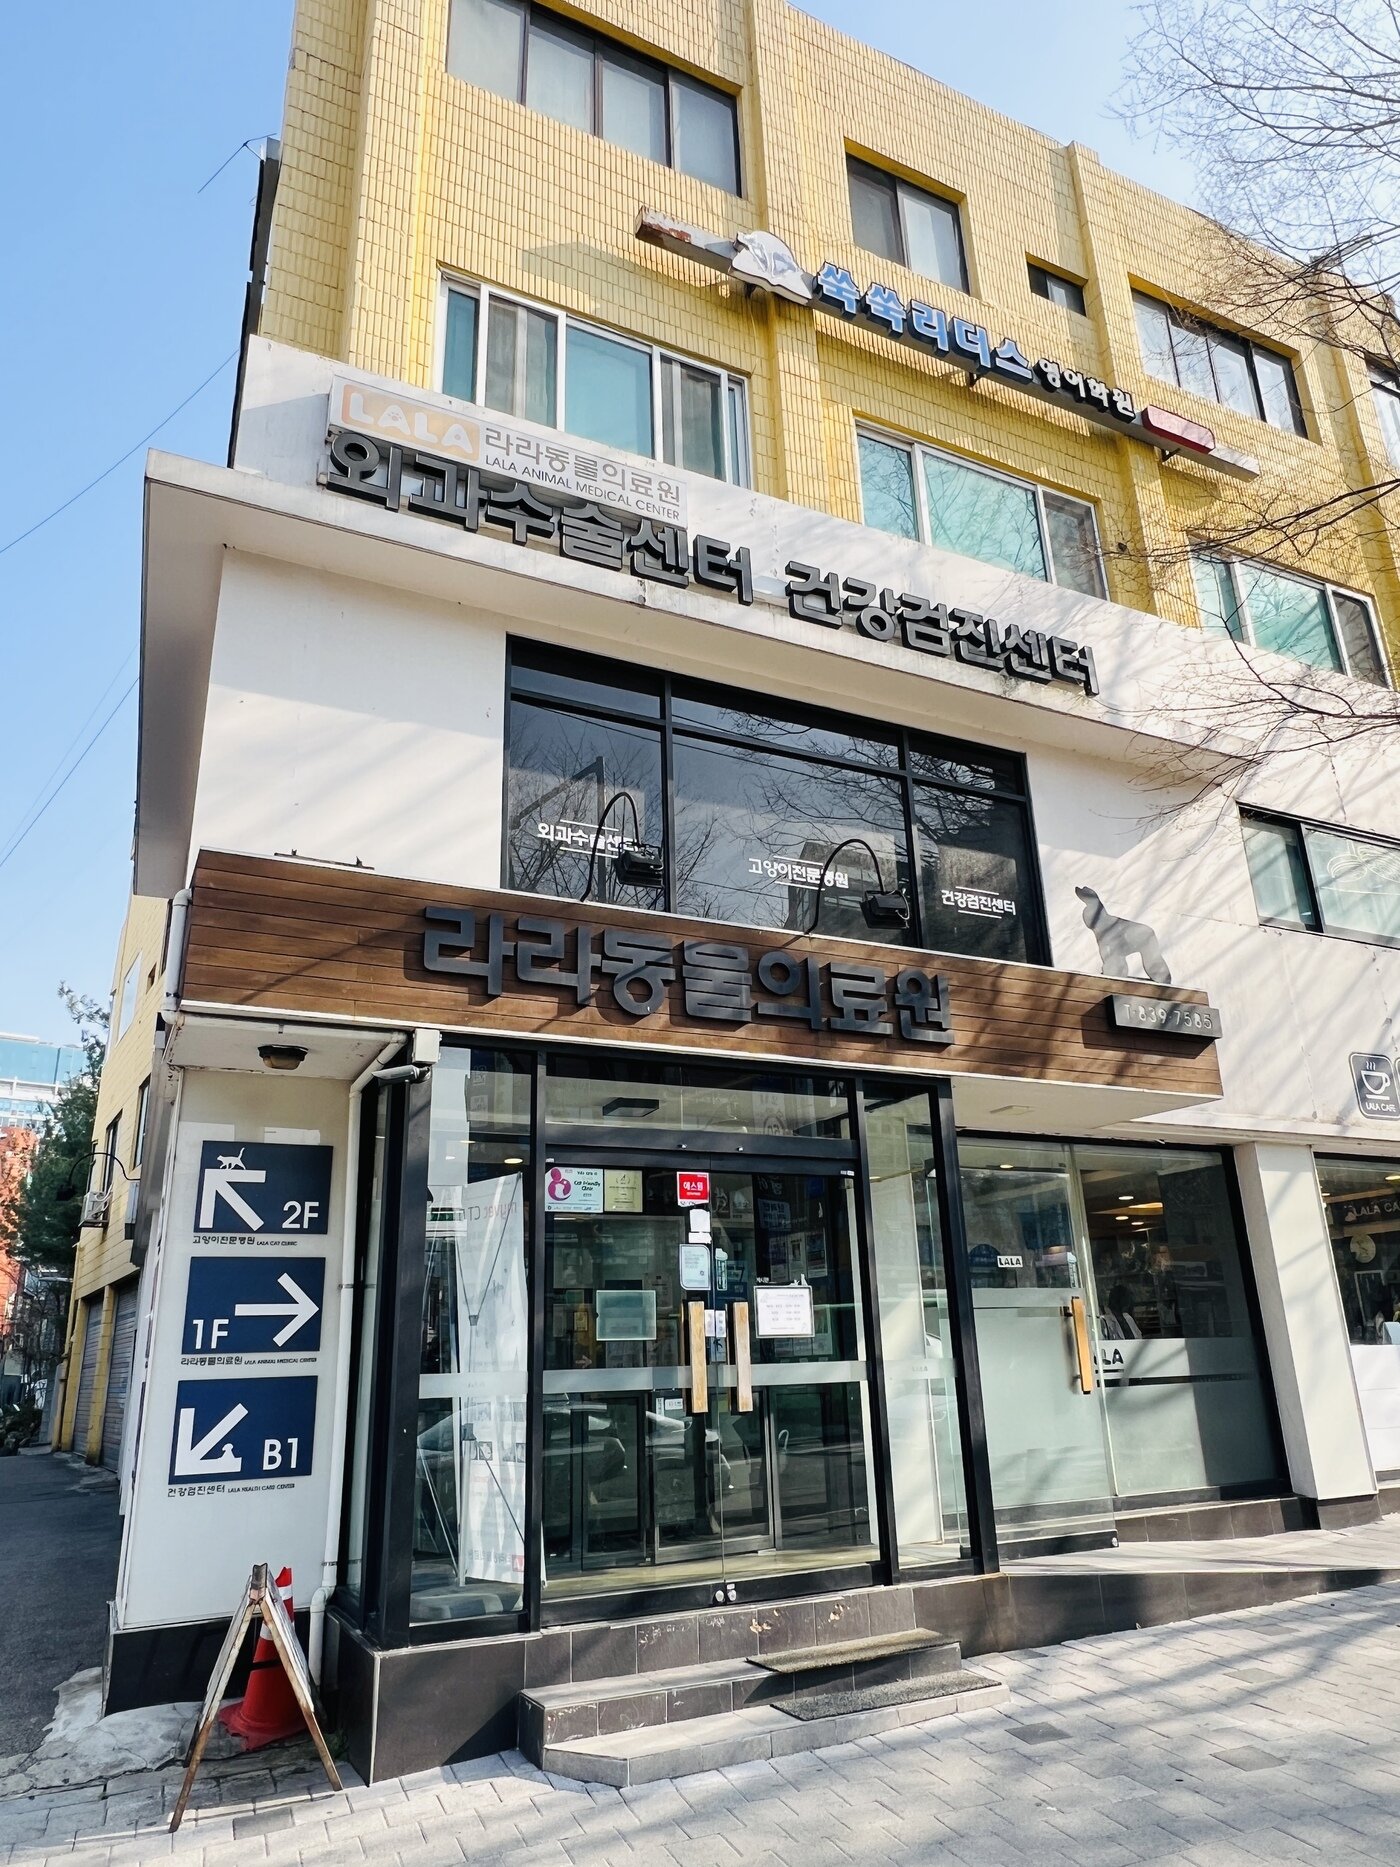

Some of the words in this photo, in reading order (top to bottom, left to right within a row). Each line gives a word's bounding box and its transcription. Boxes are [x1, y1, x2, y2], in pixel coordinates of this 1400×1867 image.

[816, 261, 1034, 383] 쑥쑥리더스
[1035, 357, 1136, 424] 영어학원
[347, 392, 475, 455] LALA
[485, 427, 680, 508] 라라동물의료원
[485, 454, 518, 474] LALA
[521, 466, 573, 490] ANIMAL
[576, 481, 632, 507] MEDICAL
[635, 499, 680, 522] CENTER
[327, 431, 754, 606] 외과수술센터
[785, 560, 1100, 698] 건강검진센터
[748, 857, 850, 889] 고양이전문병원
[940, 889, 1017, 916] 건강검진센터
[423, 906, 956, 1045] 라라동물의료원
[281, 1200, 320, 1230] 2F
[193, 1235, 256, 1245] 고양이전문병원
[998, 1257, 1022, 1267] LALA
[192, 1318, 230, 1350] 1F
[180, 1355, 243, 1367] 라라동물의료원
[262, 1437, 300, 1472] B1
